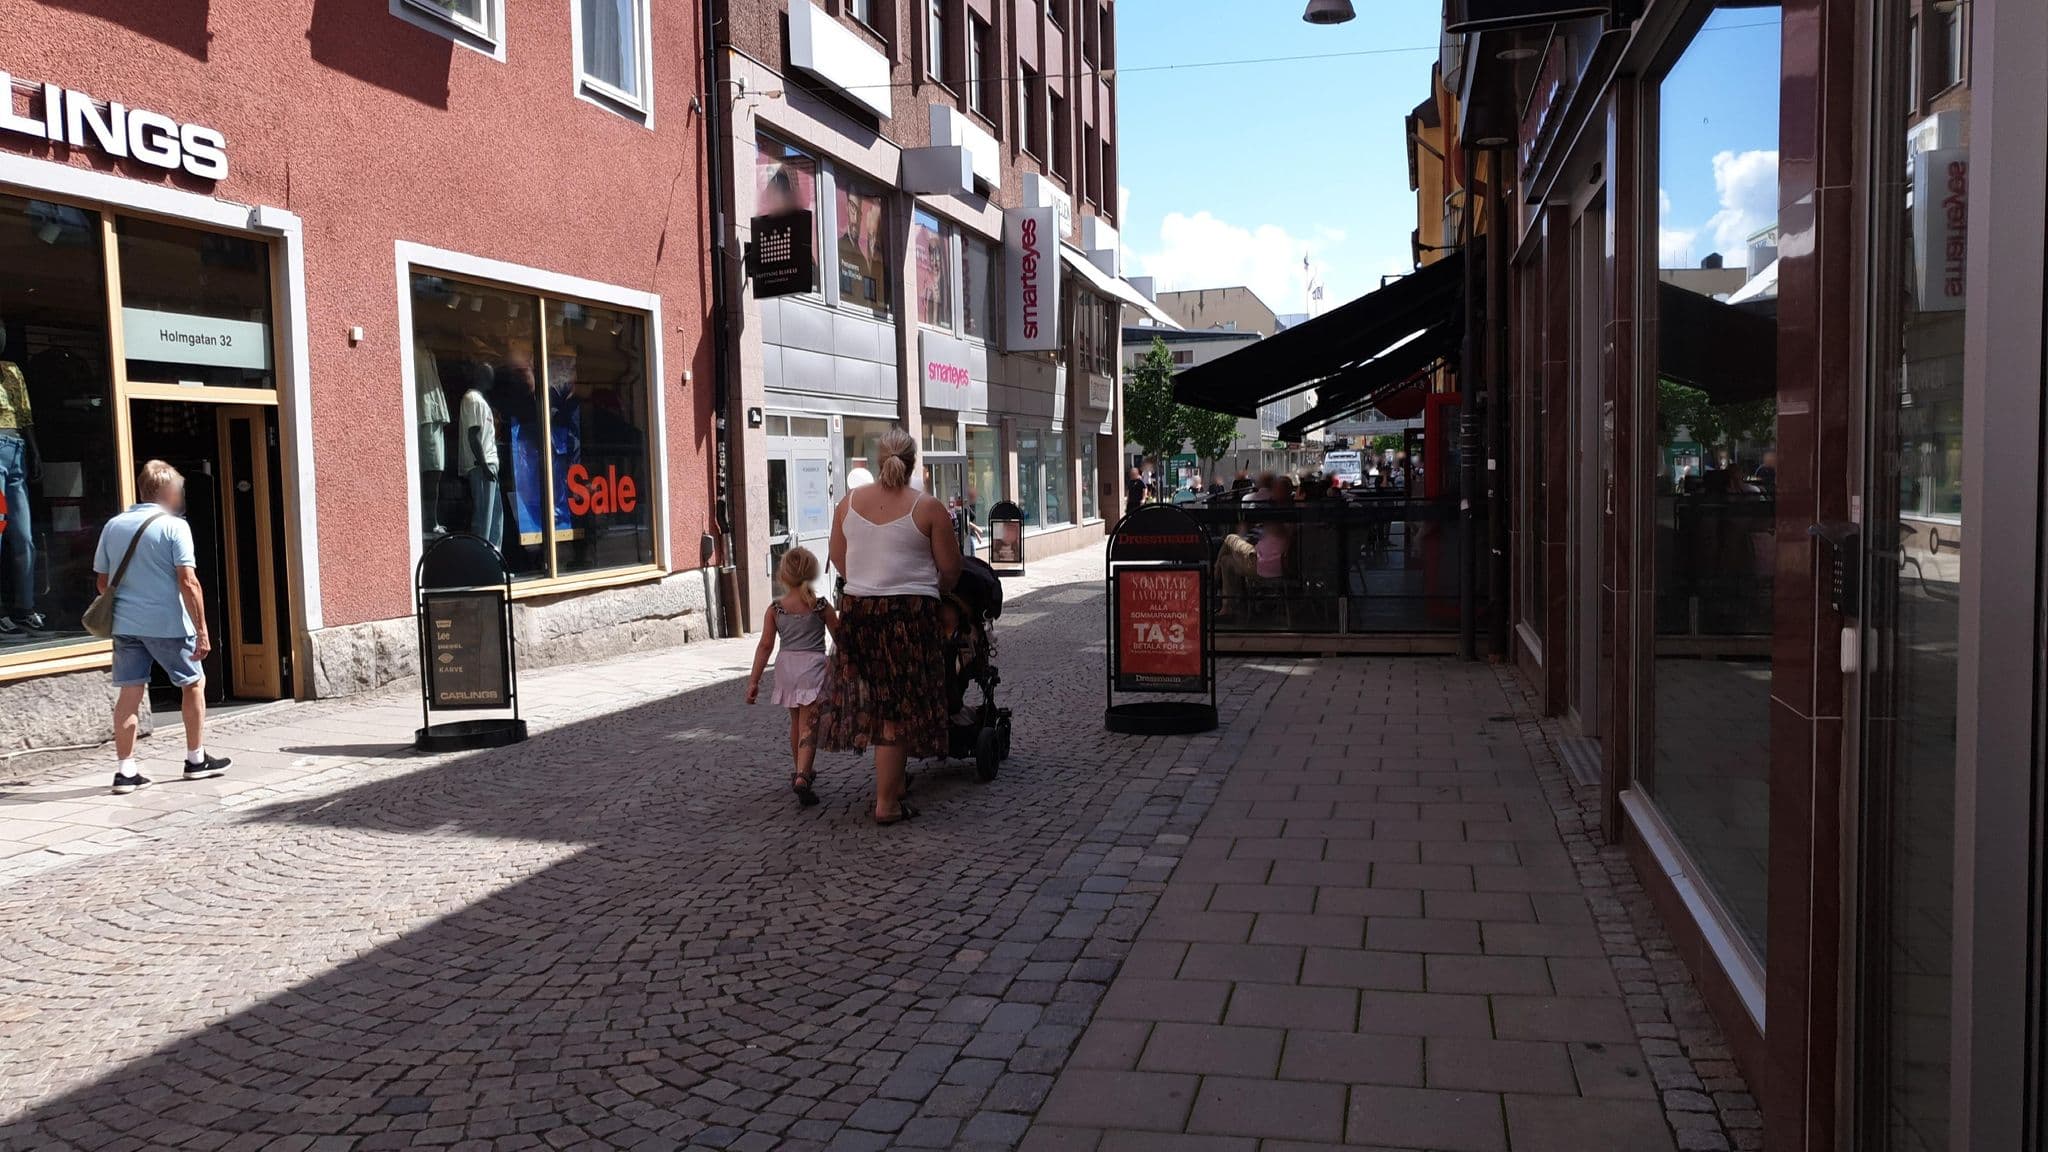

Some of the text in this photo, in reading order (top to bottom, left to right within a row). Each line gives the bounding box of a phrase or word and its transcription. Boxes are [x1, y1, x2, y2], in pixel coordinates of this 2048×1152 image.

[1021, 218, 1041, 340] smarteyes
[160, 329, 232, 347] Holmgatan 32
[928, 361, 969, 390] smarteyes
[567, 463, 636, 516] Sale
[1131, 575, 1187, 590] SOMMAR
[1133, 624, 1184, 643] TA 3
[440, 690, 498, 700] CARLINGS
